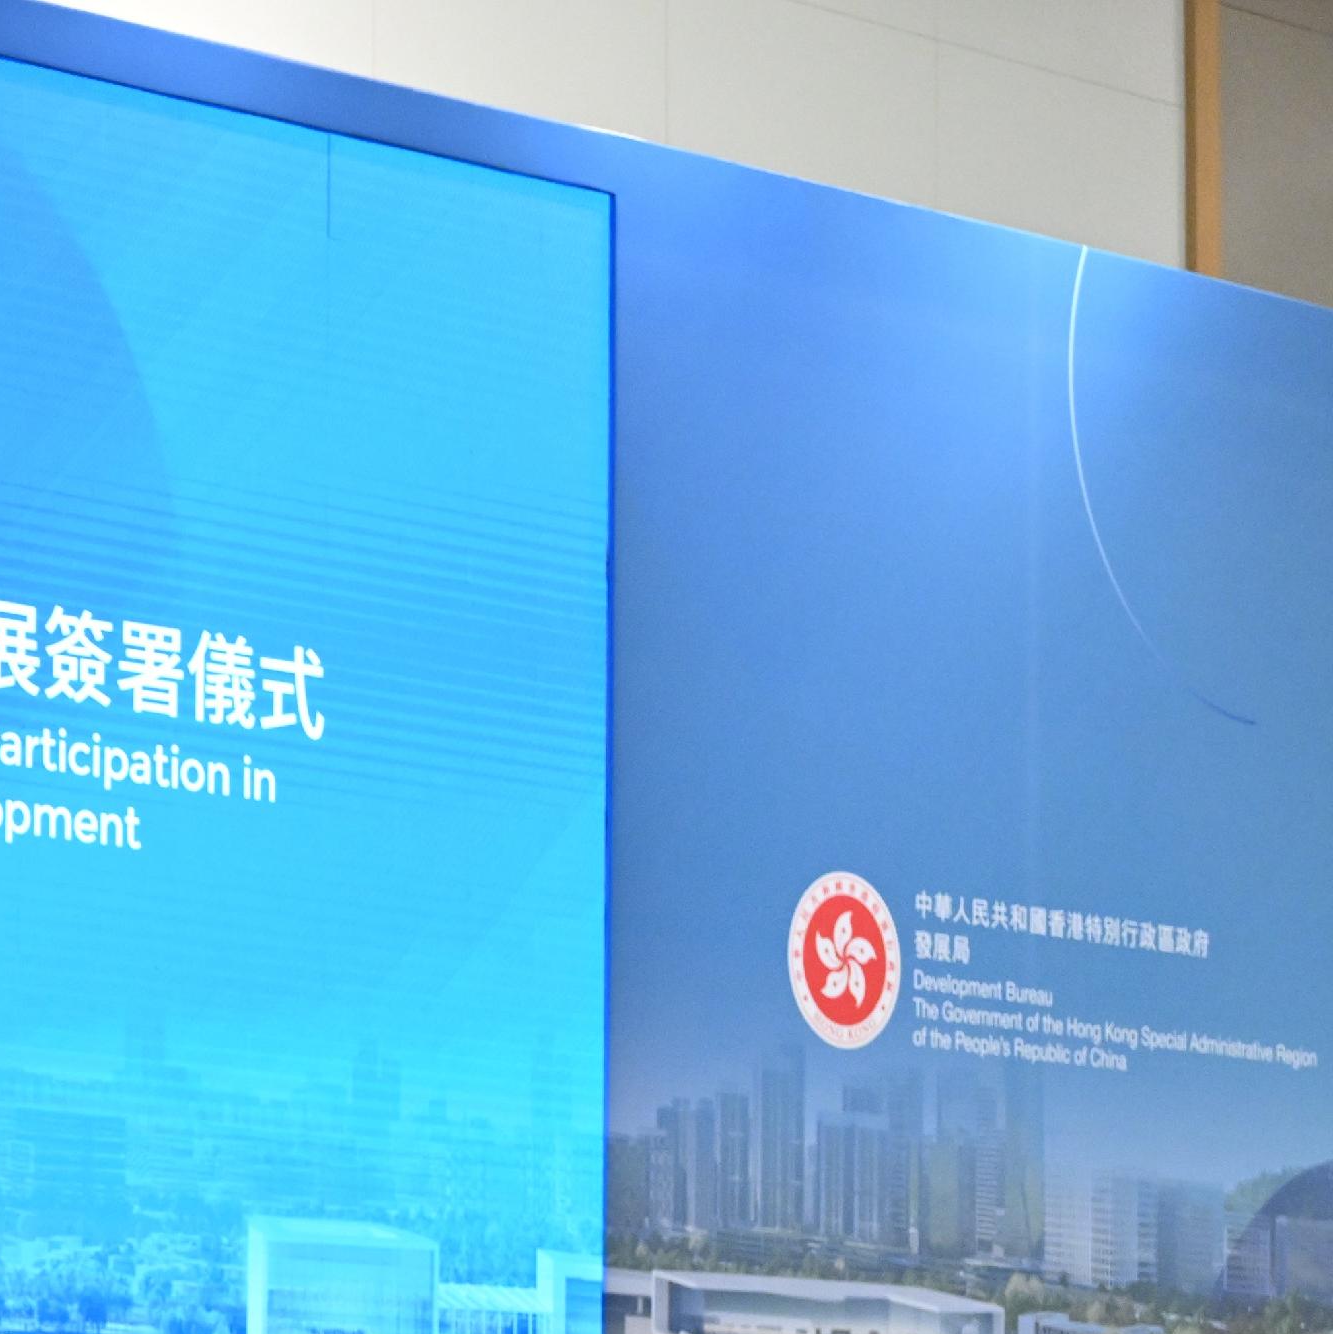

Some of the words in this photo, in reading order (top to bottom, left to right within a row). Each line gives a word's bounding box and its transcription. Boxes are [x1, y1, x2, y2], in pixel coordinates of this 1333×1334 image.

[242, 755, 277, 803] in
[915, 929, 970, 965] 發展局
[913, 969, 1002, 999] Development
[1005, 980, 1053, 1008] Bureau
[912, 1026, 927, 1047] of
[930, 1027, 952, 1050] the
[1014, 1037, 1071, 1064] Republic
[1073, 1047, 1088, 1066] of
[1090, 1047, 1127, 1072] China
[913, 996, 939, 1020] The
[941, 999, 1023, 1031] Government
[1025, 1012, 1040, 1033] of
[1042, 1013, 1063, 1036] the
[1067, 1017, 1102, 1046] Hong
[1105, 1021, 1138, 1050] Kong
[1140, 1025, 1187, 1051] Special
[1189, 1032, 1274, 1063] Administrative
[1275, 1043, 1318, 1070] Region
